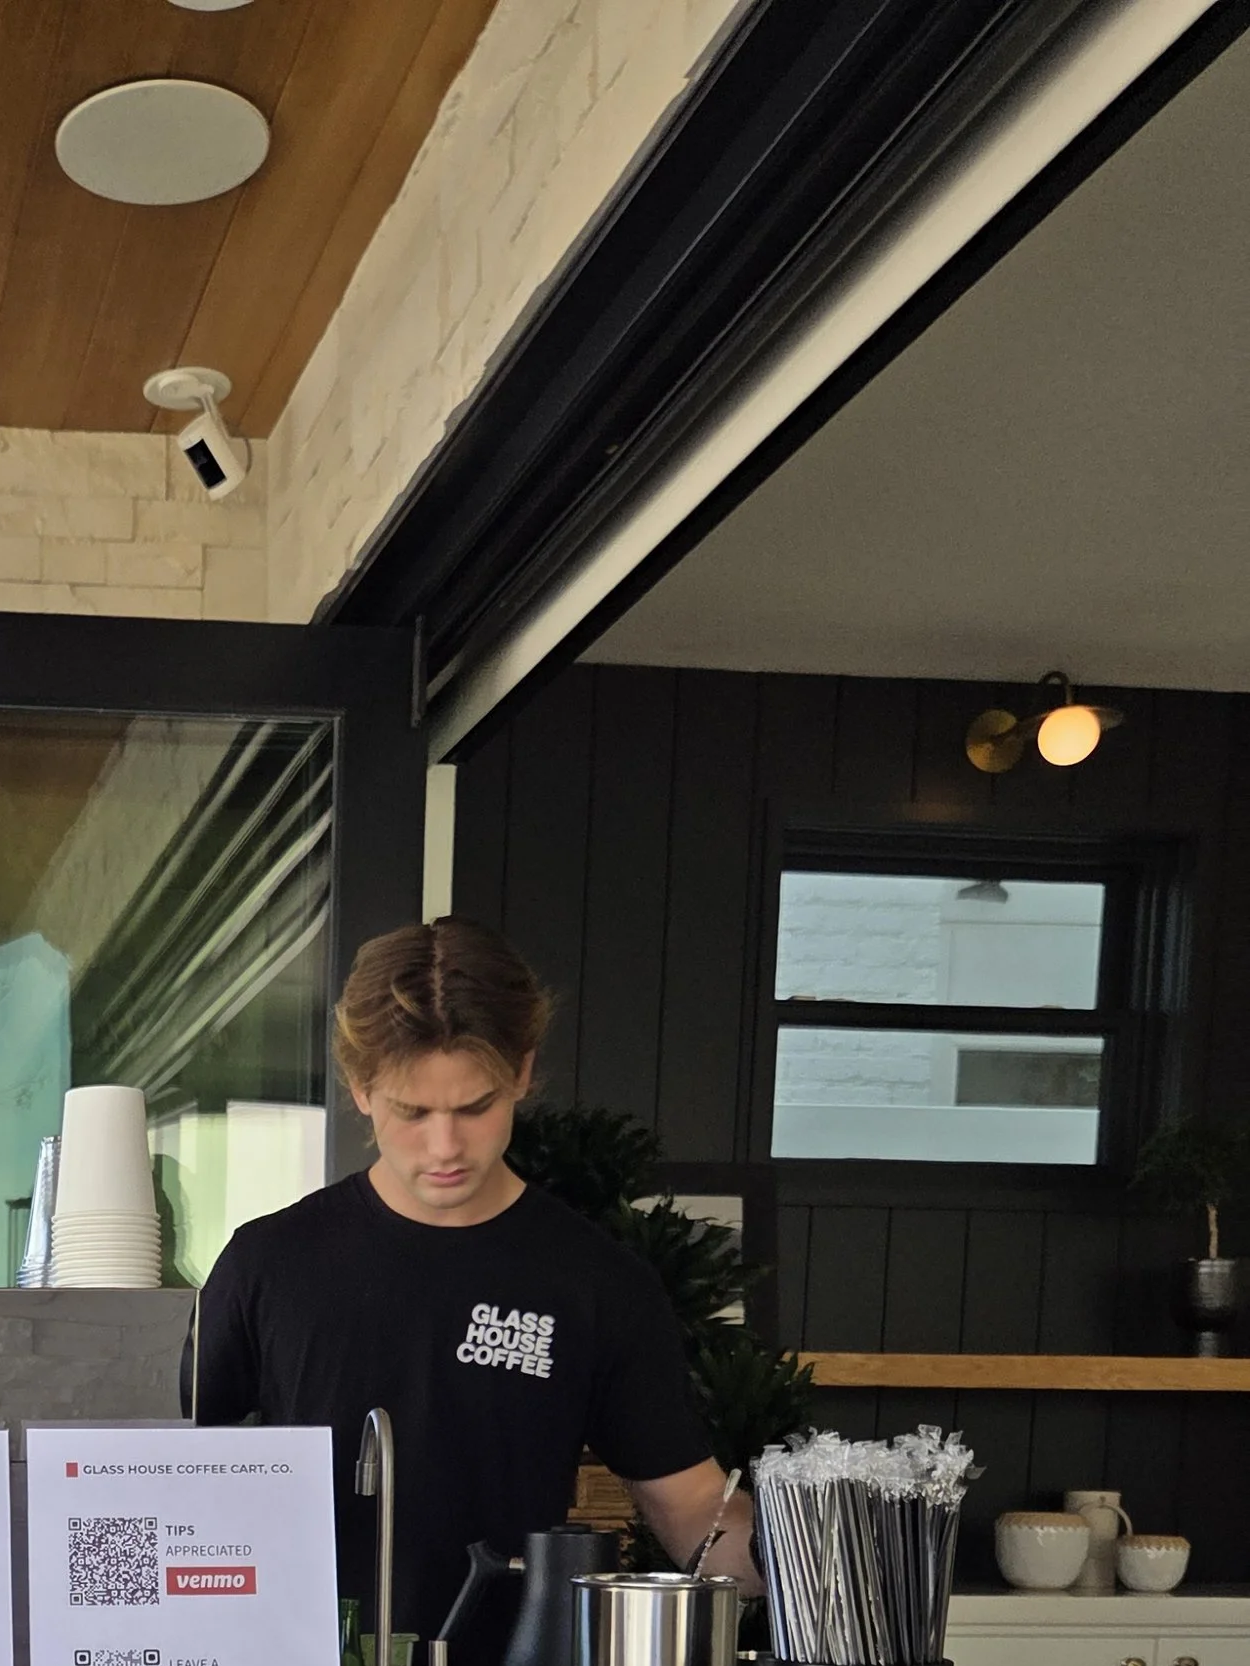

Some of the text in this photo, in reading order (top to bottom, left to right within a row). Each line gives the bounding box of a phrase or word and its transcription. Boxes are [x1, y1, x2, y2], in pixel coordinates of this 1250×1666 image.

[471, 1303, 555, 1336] GLASS
[466, 1322, 553, 1358] HOUSE
[456, 1342, 554, 1379] COFFEE
[83, 1463, 294, 1475] GLASS HOUSE COFFEE CART, CO.
[165, 1525, 195, 1536] TIPS
[165, 1545, 252, 1557] APPRECIATED
[176, 1573, 246, 1590] venmo
